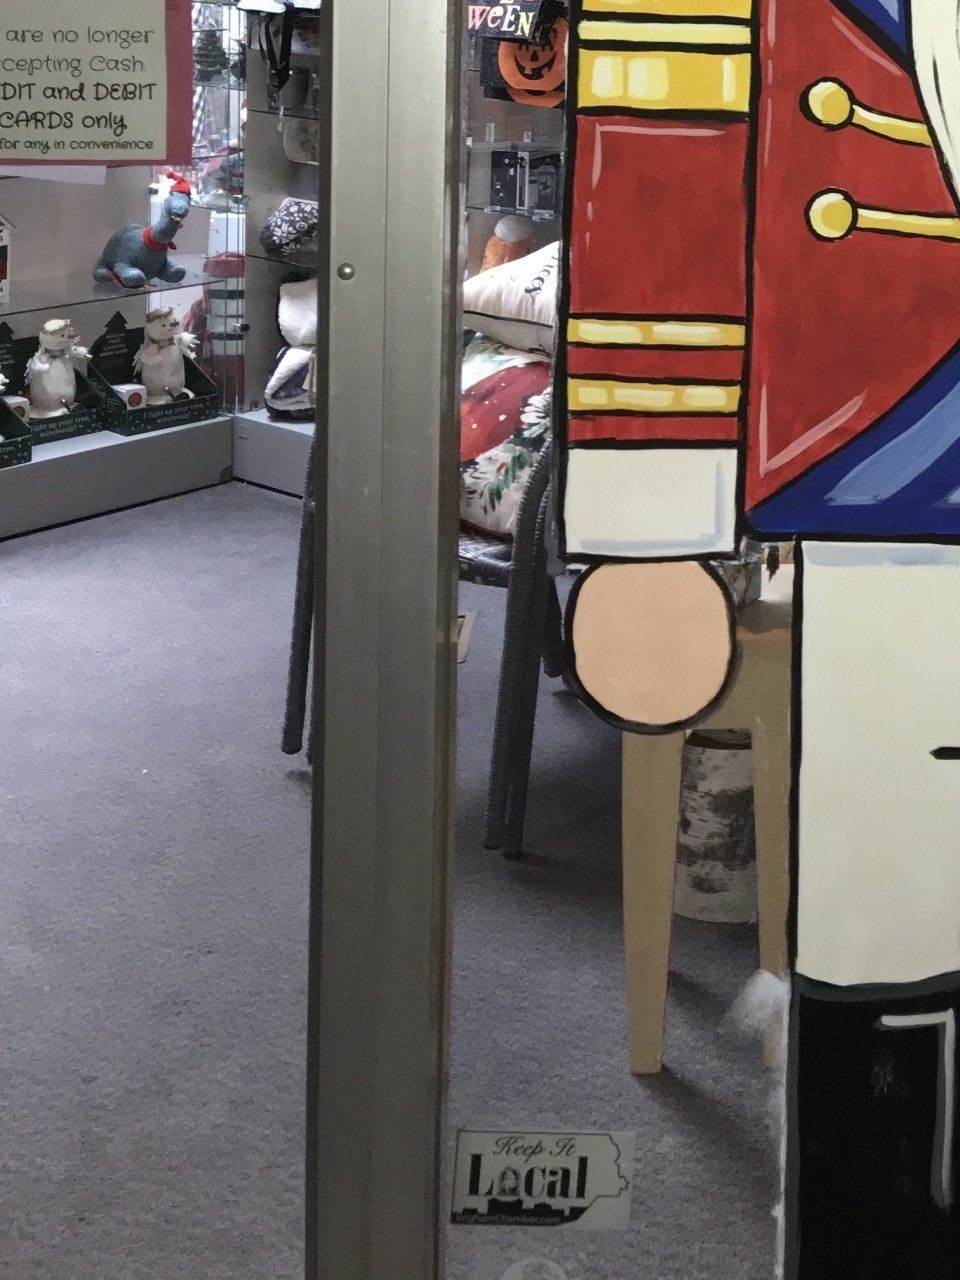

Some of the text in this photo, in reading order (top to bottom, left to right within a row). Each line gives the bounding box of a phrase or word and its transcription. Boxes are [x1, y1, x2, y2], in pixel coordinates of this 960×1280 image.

[5, 26, 155, 49] are no longer
[43, 82, 86, 101] and
[93, 82, 157, 101] DEBIT
[0, 110, 74, 130] CARDS
[24, 140, 50, 155] any
[69, 139, 154, 150] convenience
[492, 1135, 578, 1164] Keep It
[467, 1153, 589, 1200] Local
